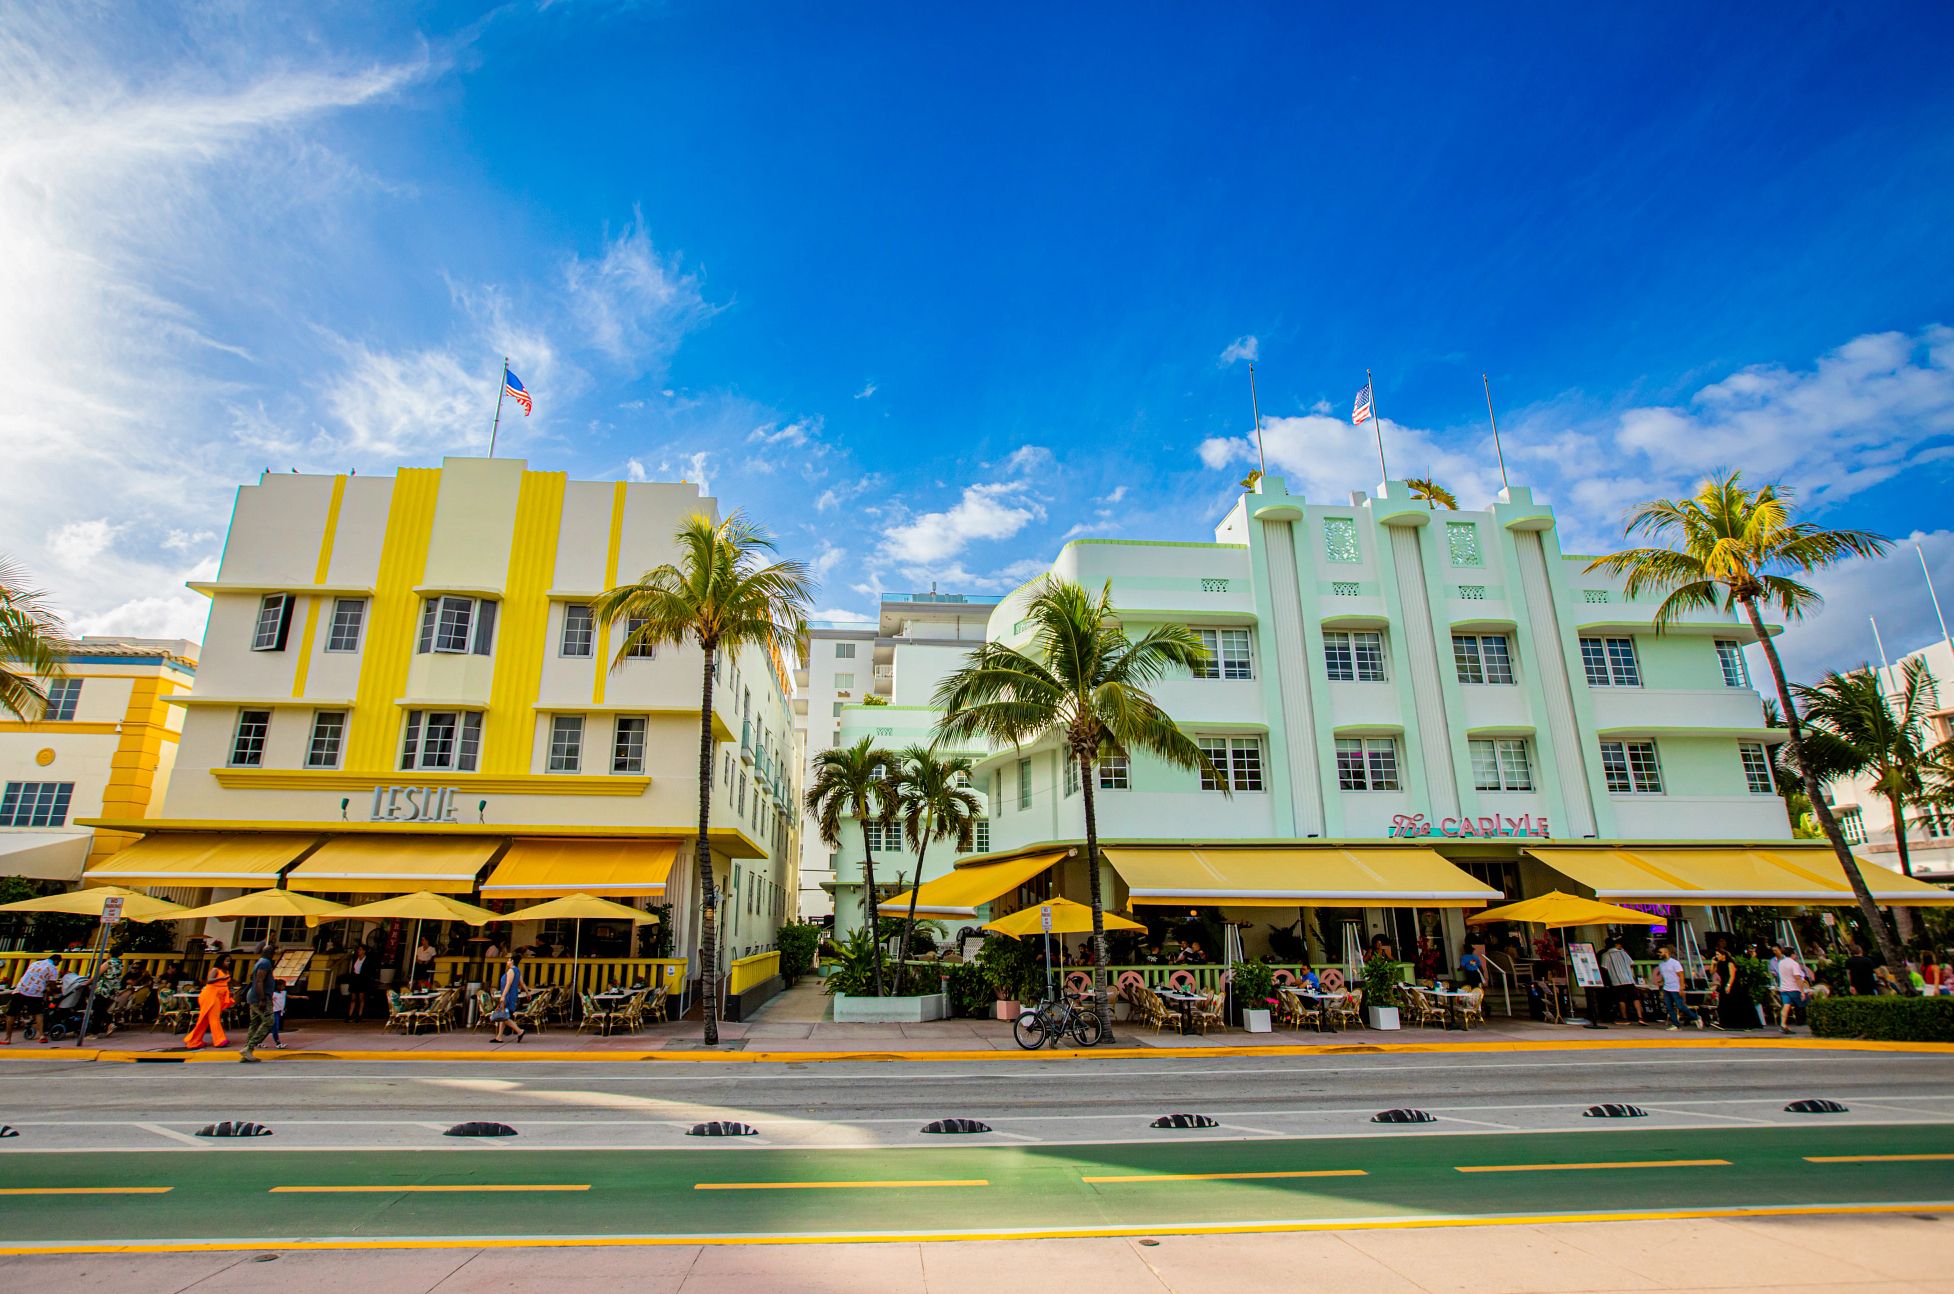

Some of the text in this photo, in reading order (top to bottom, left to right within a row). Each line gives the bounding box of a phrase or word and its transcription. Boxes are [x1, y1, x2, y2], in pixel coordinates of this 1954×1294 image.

[371, 786, 459, 821] LESLIE
[1393, 813, 1549, 837] The CARLYLE
